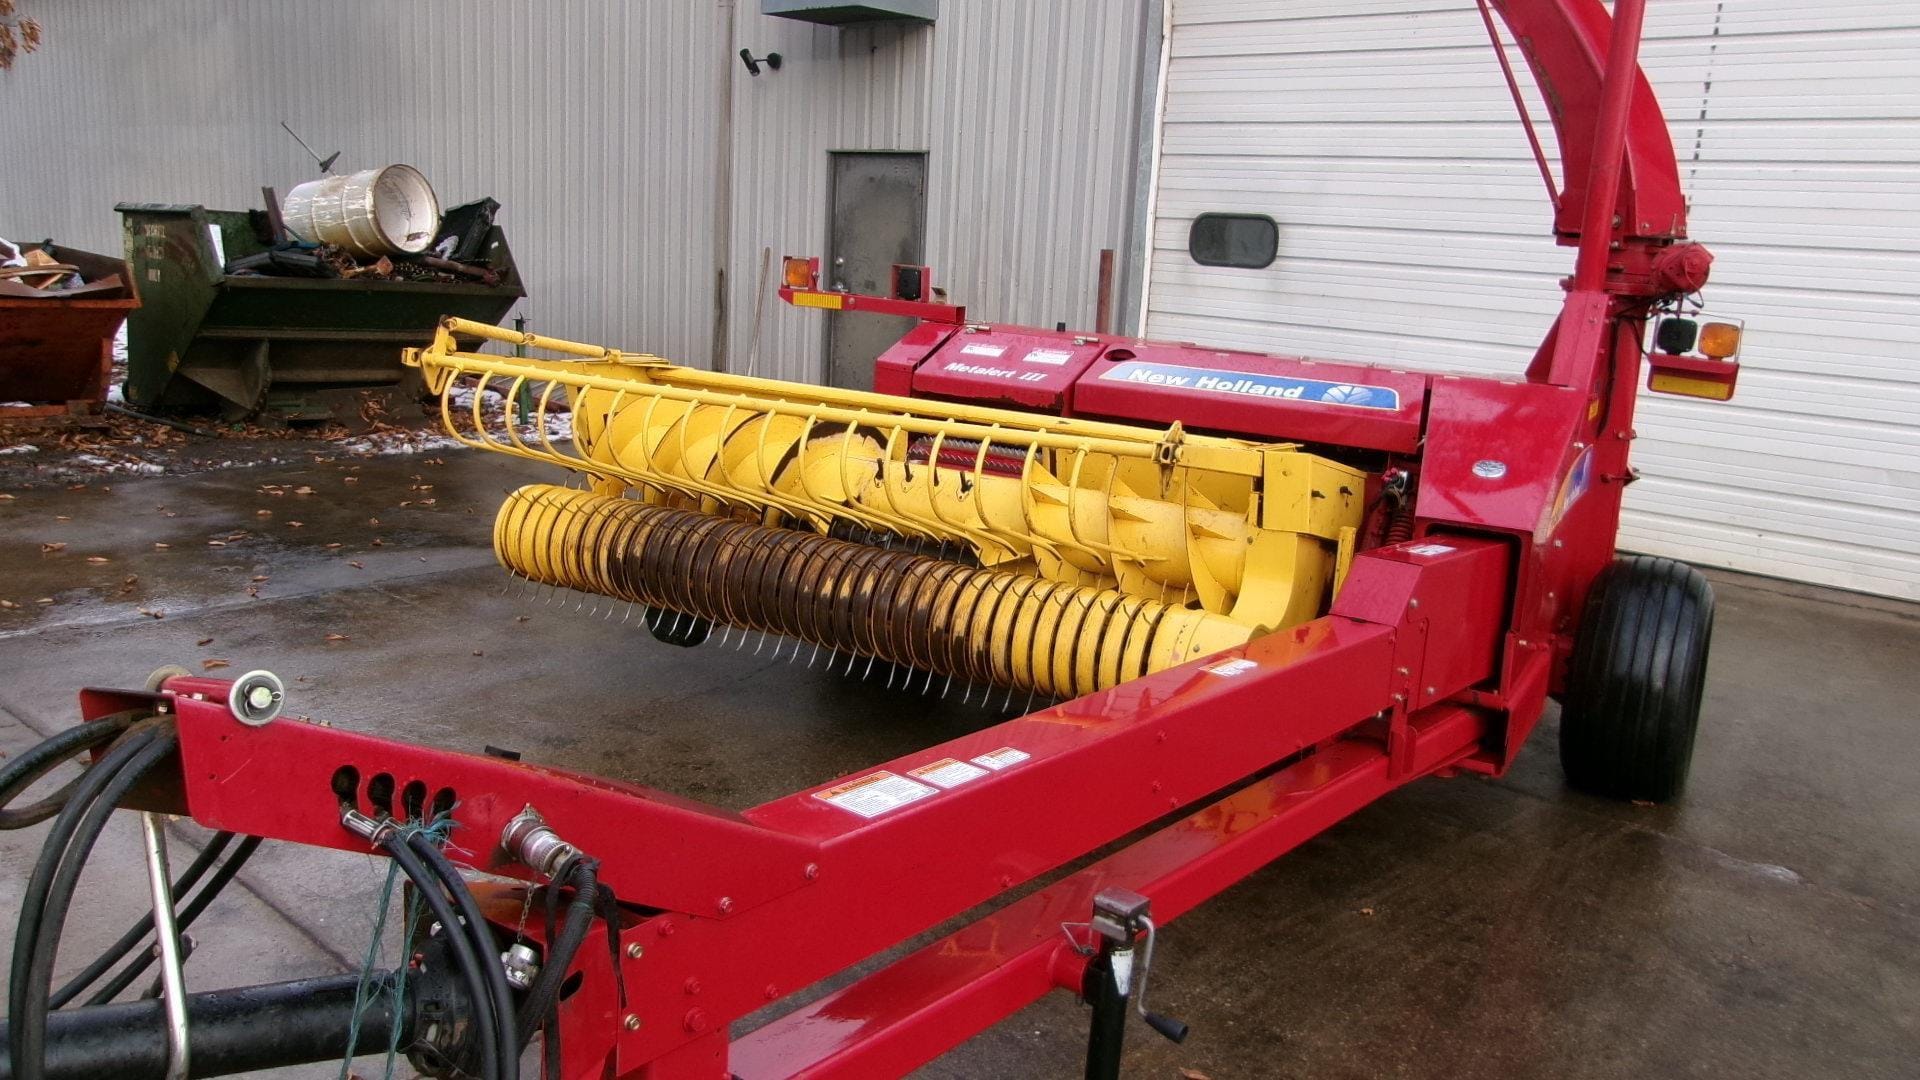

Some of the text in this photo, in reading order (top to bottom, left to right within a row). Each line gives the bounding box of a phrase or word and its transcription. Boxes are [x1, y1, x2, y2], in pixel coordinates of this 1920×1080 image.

[943, 362, 1017, 378] Metalert
[1127, 369, 1305, 399] New Holland
